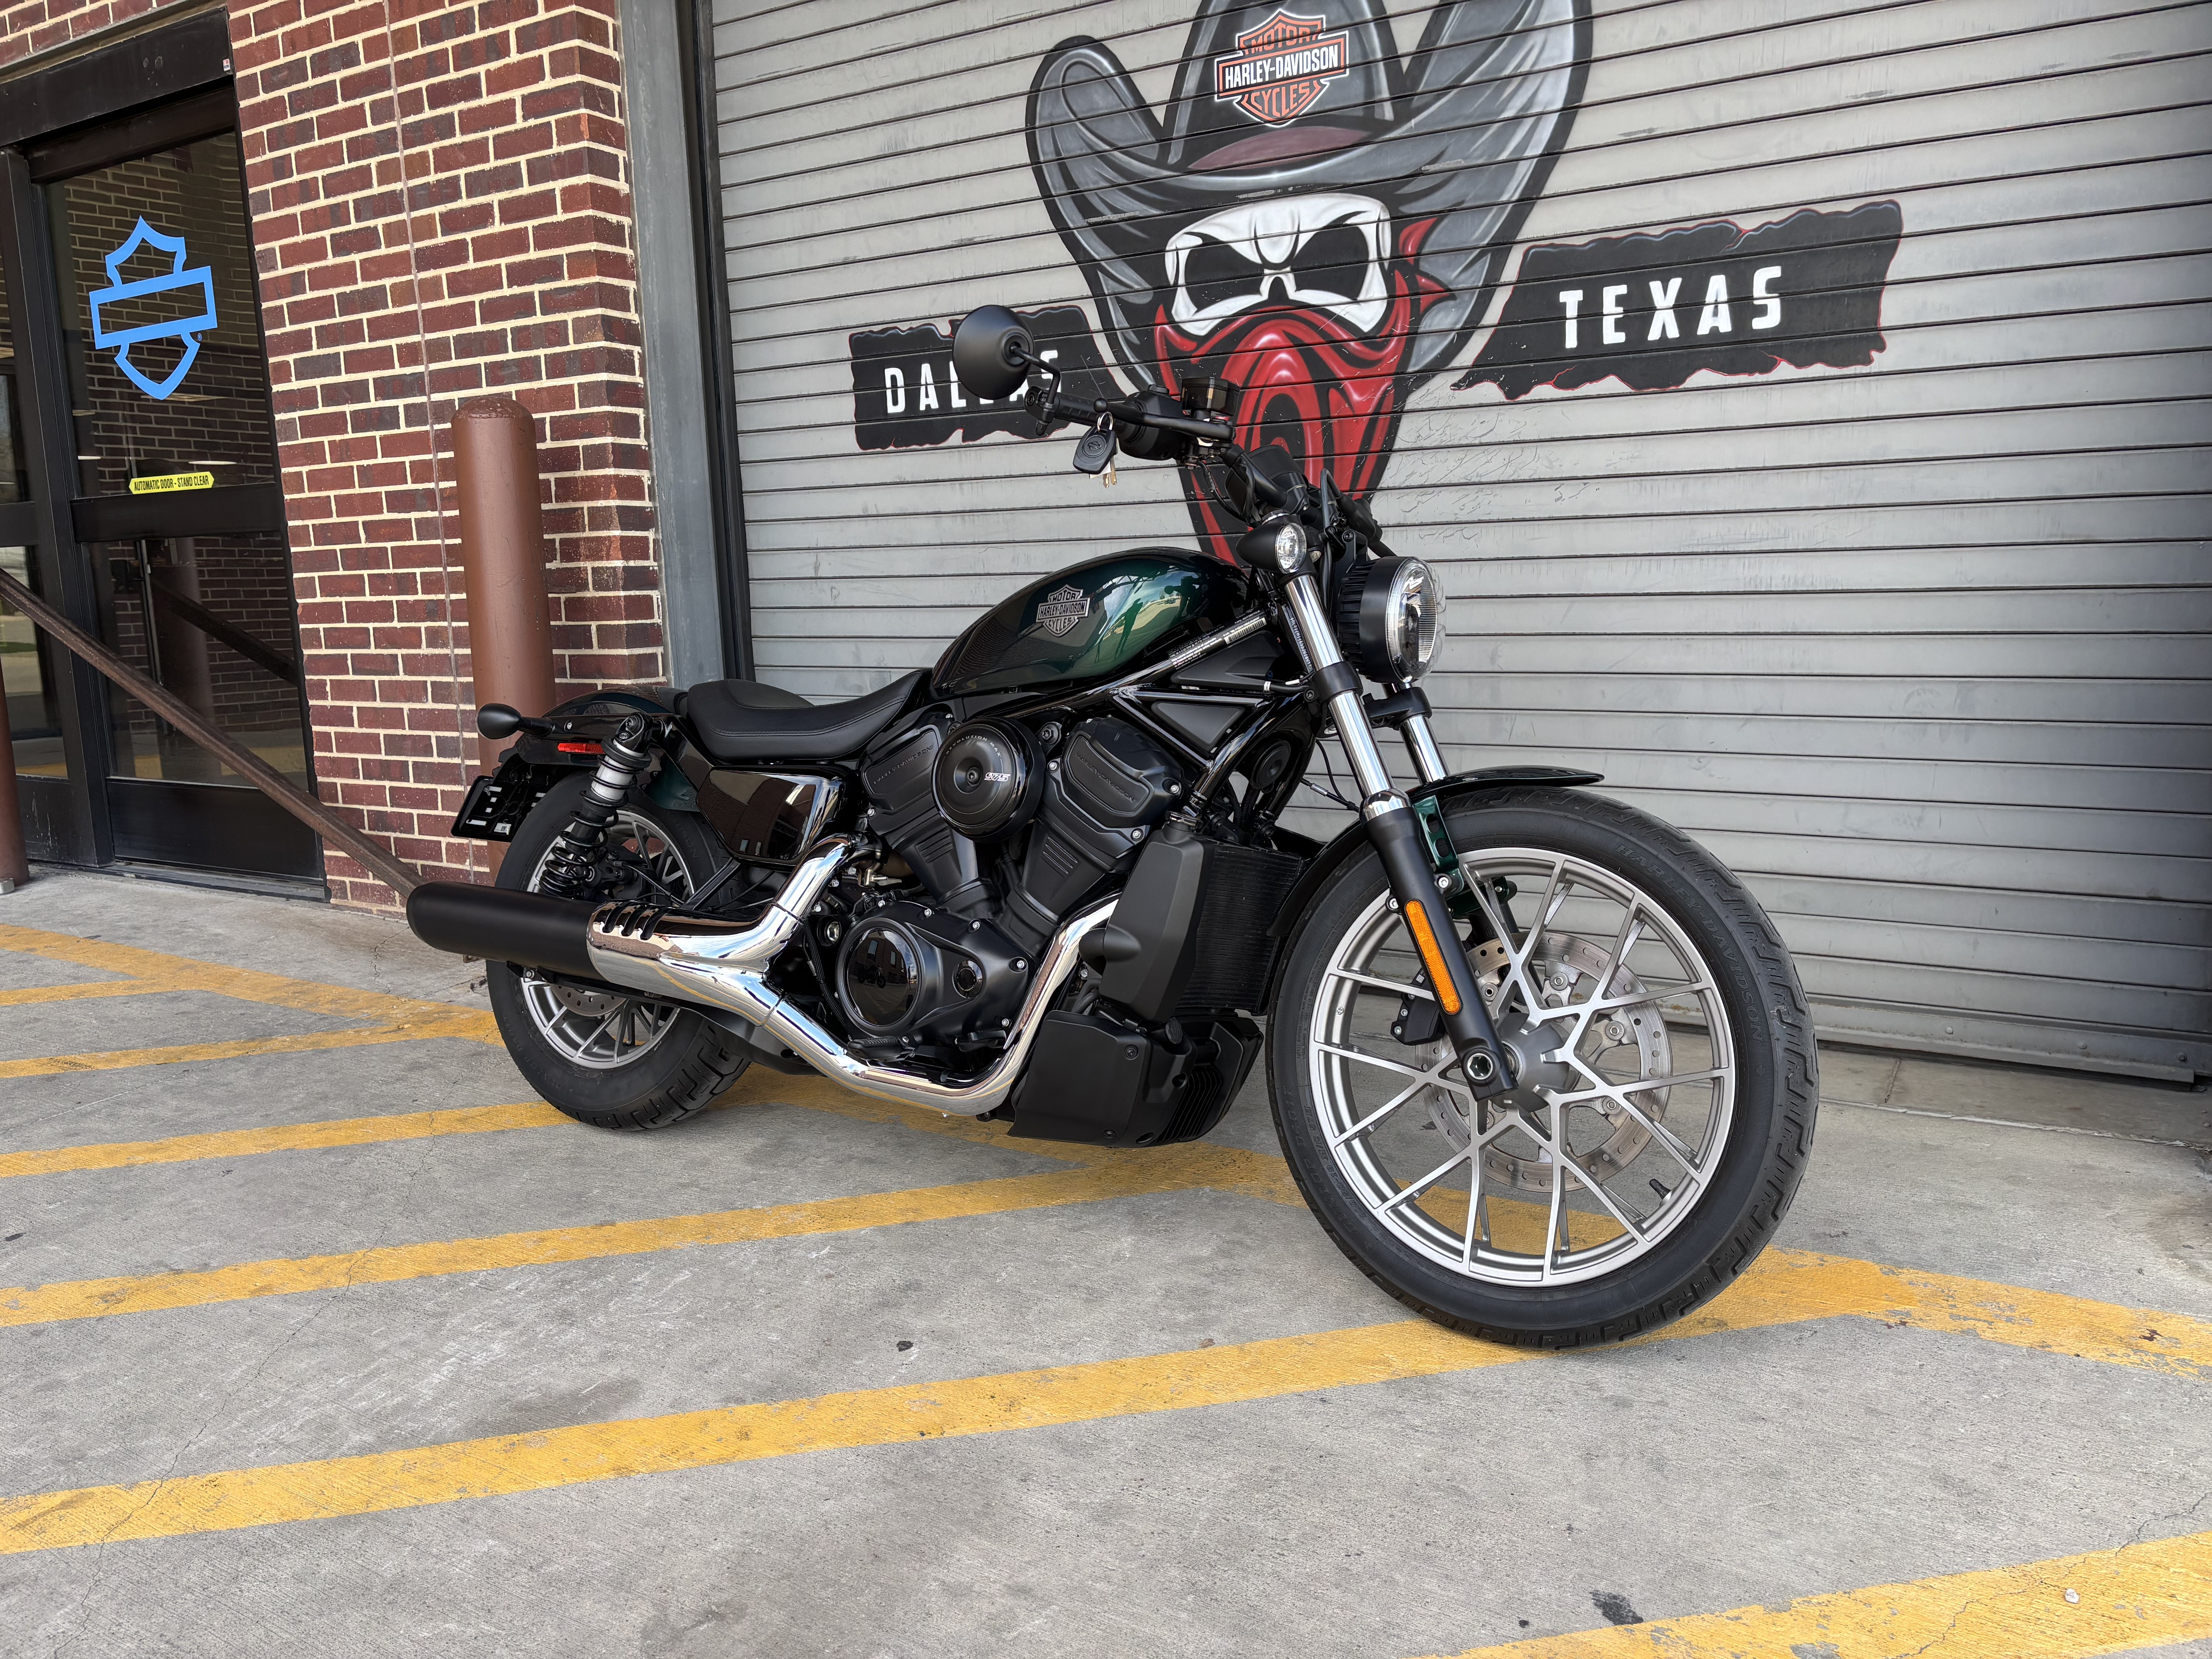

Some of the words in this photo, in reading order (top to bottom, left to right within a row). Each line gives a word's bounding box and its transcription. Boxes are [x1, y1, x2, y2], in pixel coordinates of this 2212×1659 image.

[1251, 22, 1310, 53] MOTOR
[1225, 45, 1338, 89] HARLEY-DAVIDSON
[1250, 82, 1310, 117] CYCLES
[1559, 265, 1782, 349] TEXAS
[134, 479, 160, 491] AUTOMATIC
[160, 478, 174, 489] DOOR
[177, 476, 193, 488] STAND
[194, 475, 209, 486] CLEAR
[1052, 589, 1076, 602] MOTOR
[1039, 601, 1085, 618] HARLEY-DAVIDSON
[1048, 617, 1072, 632] CYCLES
[946, 735, 988, 755] REVOLUTION
[984, 772, 1011, 782] 975
[1613, 843, 1763, 1042] HARLEY-DAVIDSON
[1325, 1163, 1367, 1221] 100/90-19
